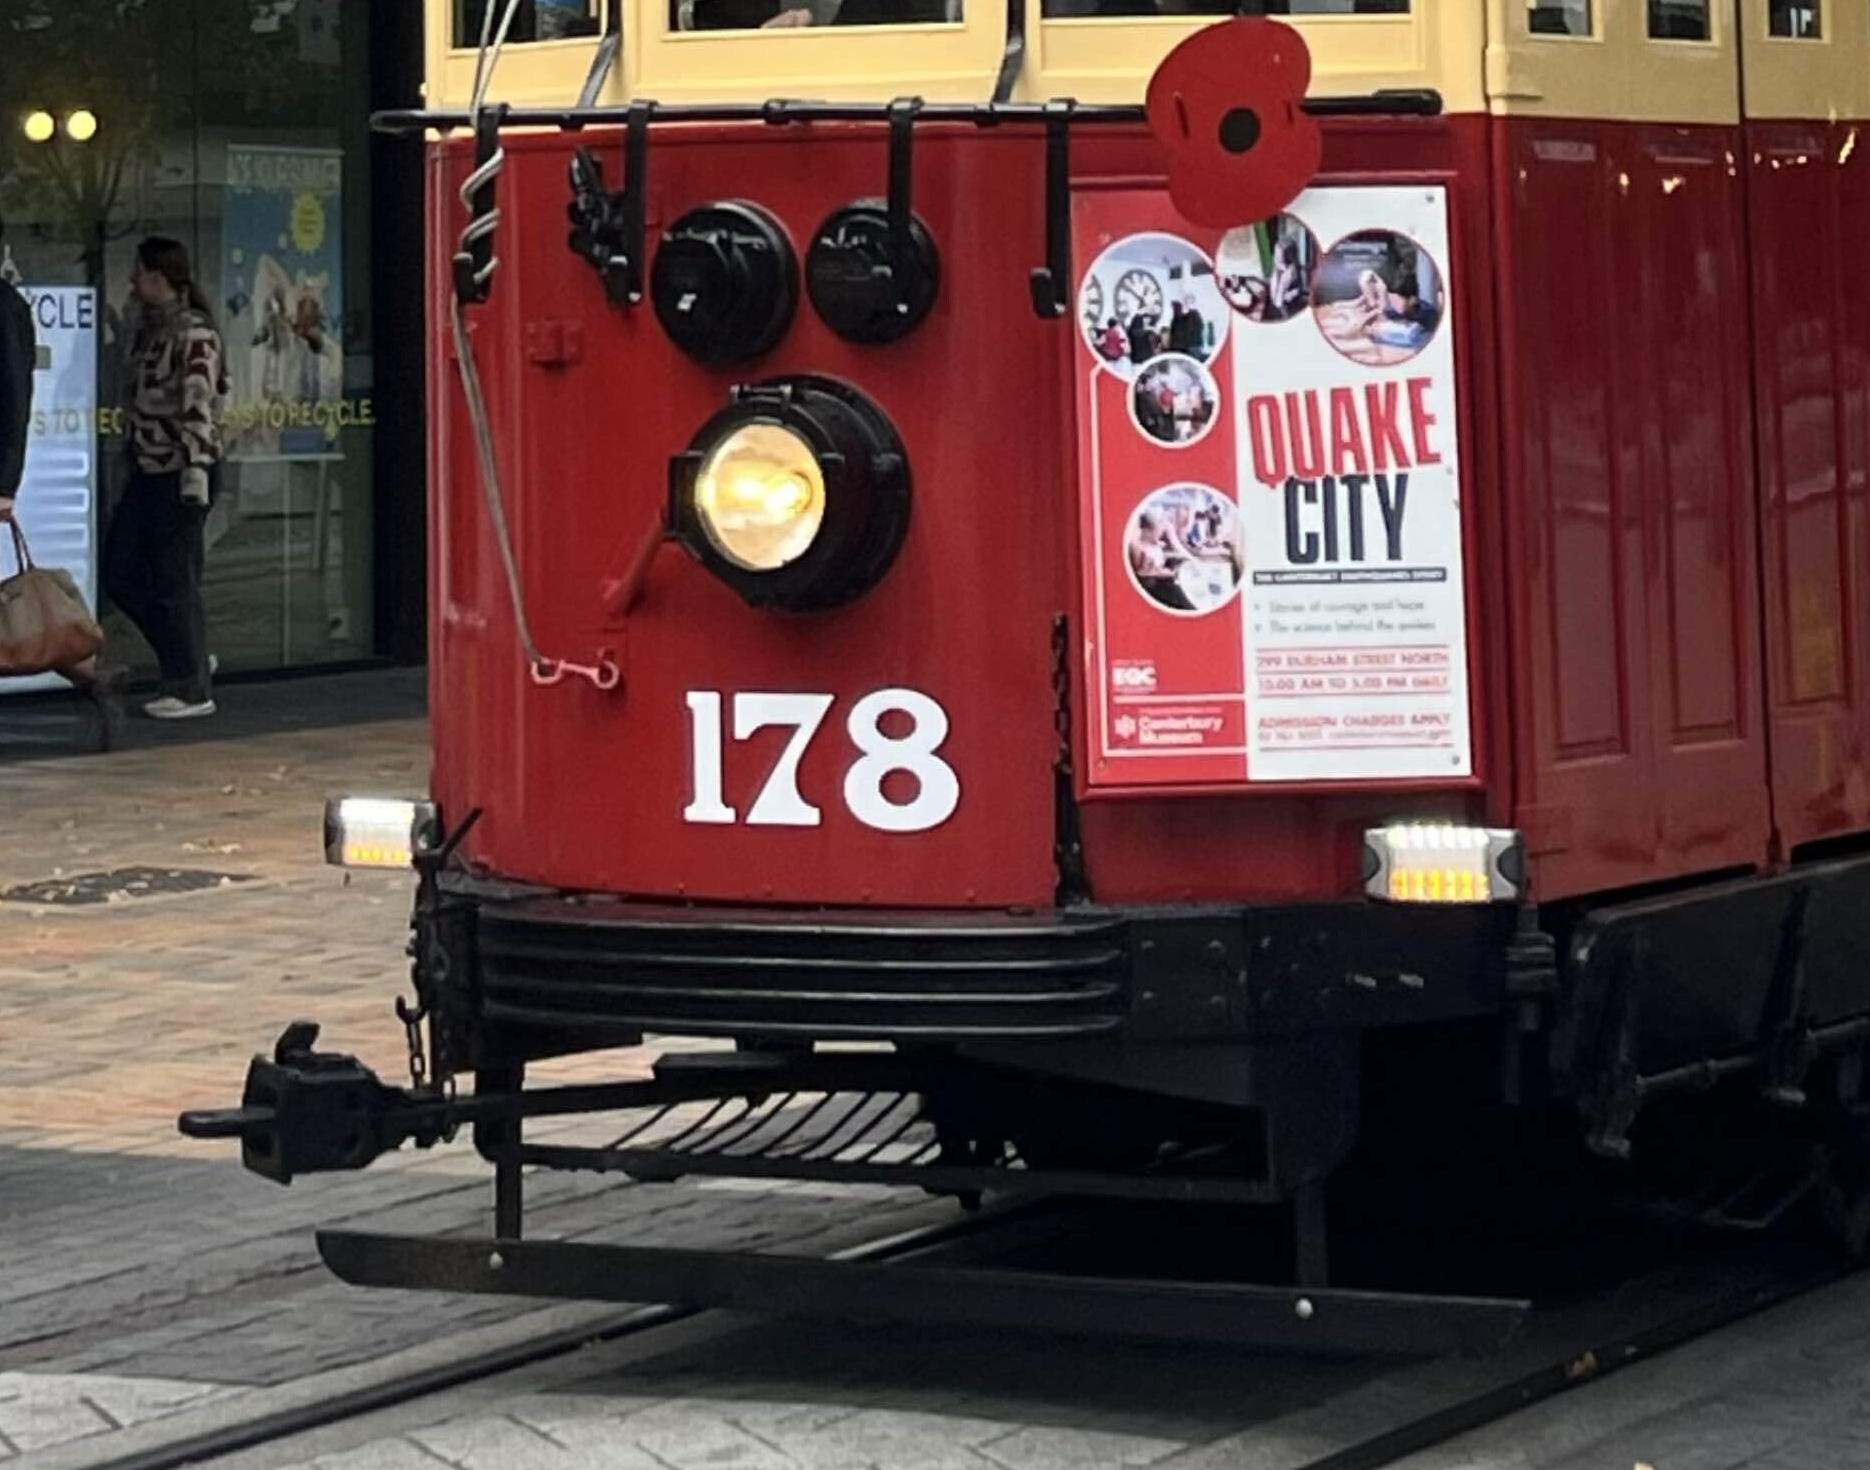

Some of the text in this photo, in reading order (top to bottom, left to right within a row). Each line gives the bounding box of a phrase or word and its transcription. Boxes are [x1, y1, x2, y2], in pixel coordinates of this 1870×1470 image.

[1247, 377, 1441, 490] QUAKE
[1285, 473, 1409, 564] CITY
[683, 688, 961, 832] 178
